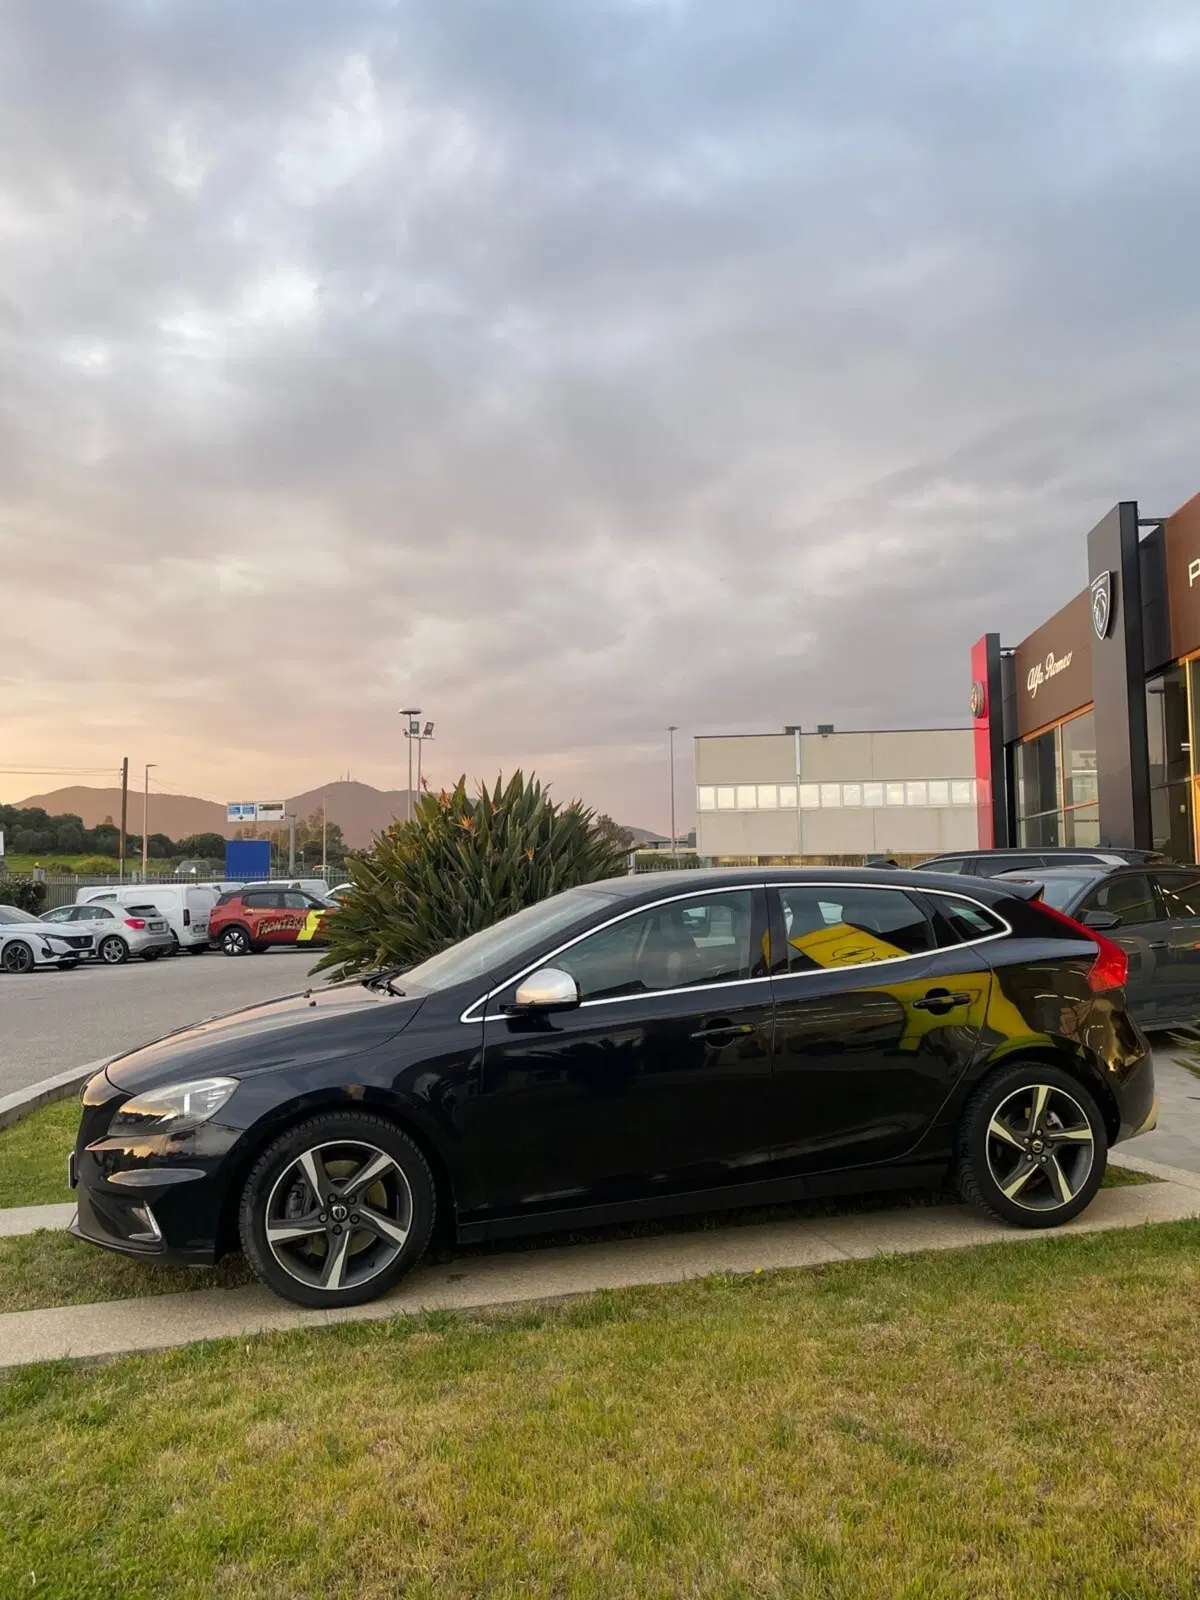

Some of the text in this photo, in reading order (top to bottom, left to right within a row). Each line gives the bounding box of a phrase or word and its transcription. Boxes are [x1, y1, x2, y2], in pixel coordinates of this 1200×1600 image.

[1027, 650, 1073, 699] Alfa Romeo
[256, 916, 307, 938] FRONTERA
